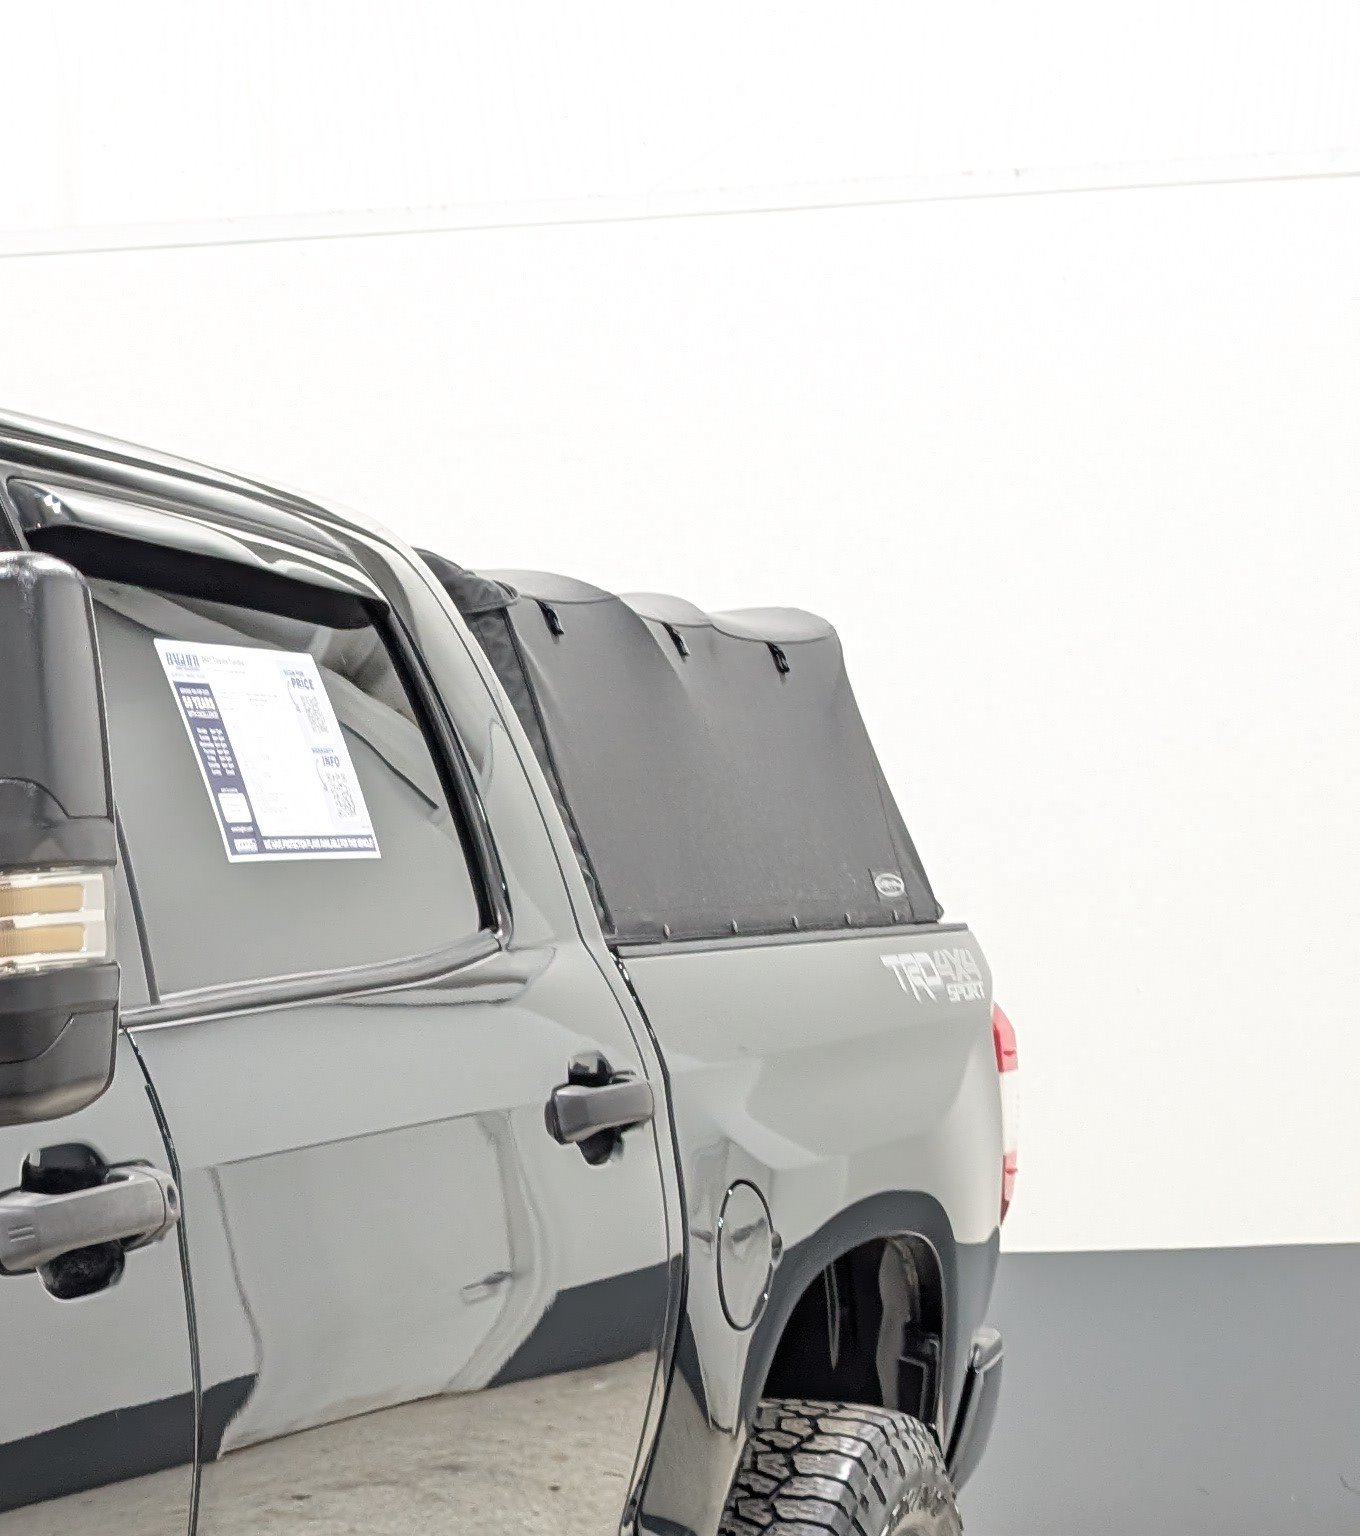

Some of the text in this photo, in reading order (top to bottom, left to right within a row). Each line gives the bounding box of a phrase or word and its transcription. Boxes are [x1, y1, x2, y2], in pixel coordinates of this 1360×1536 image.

[291, 677, 315, 691] PRICE
[322, 755, 341, 768] INFO
[880, 951, 944, 1004] TRD
